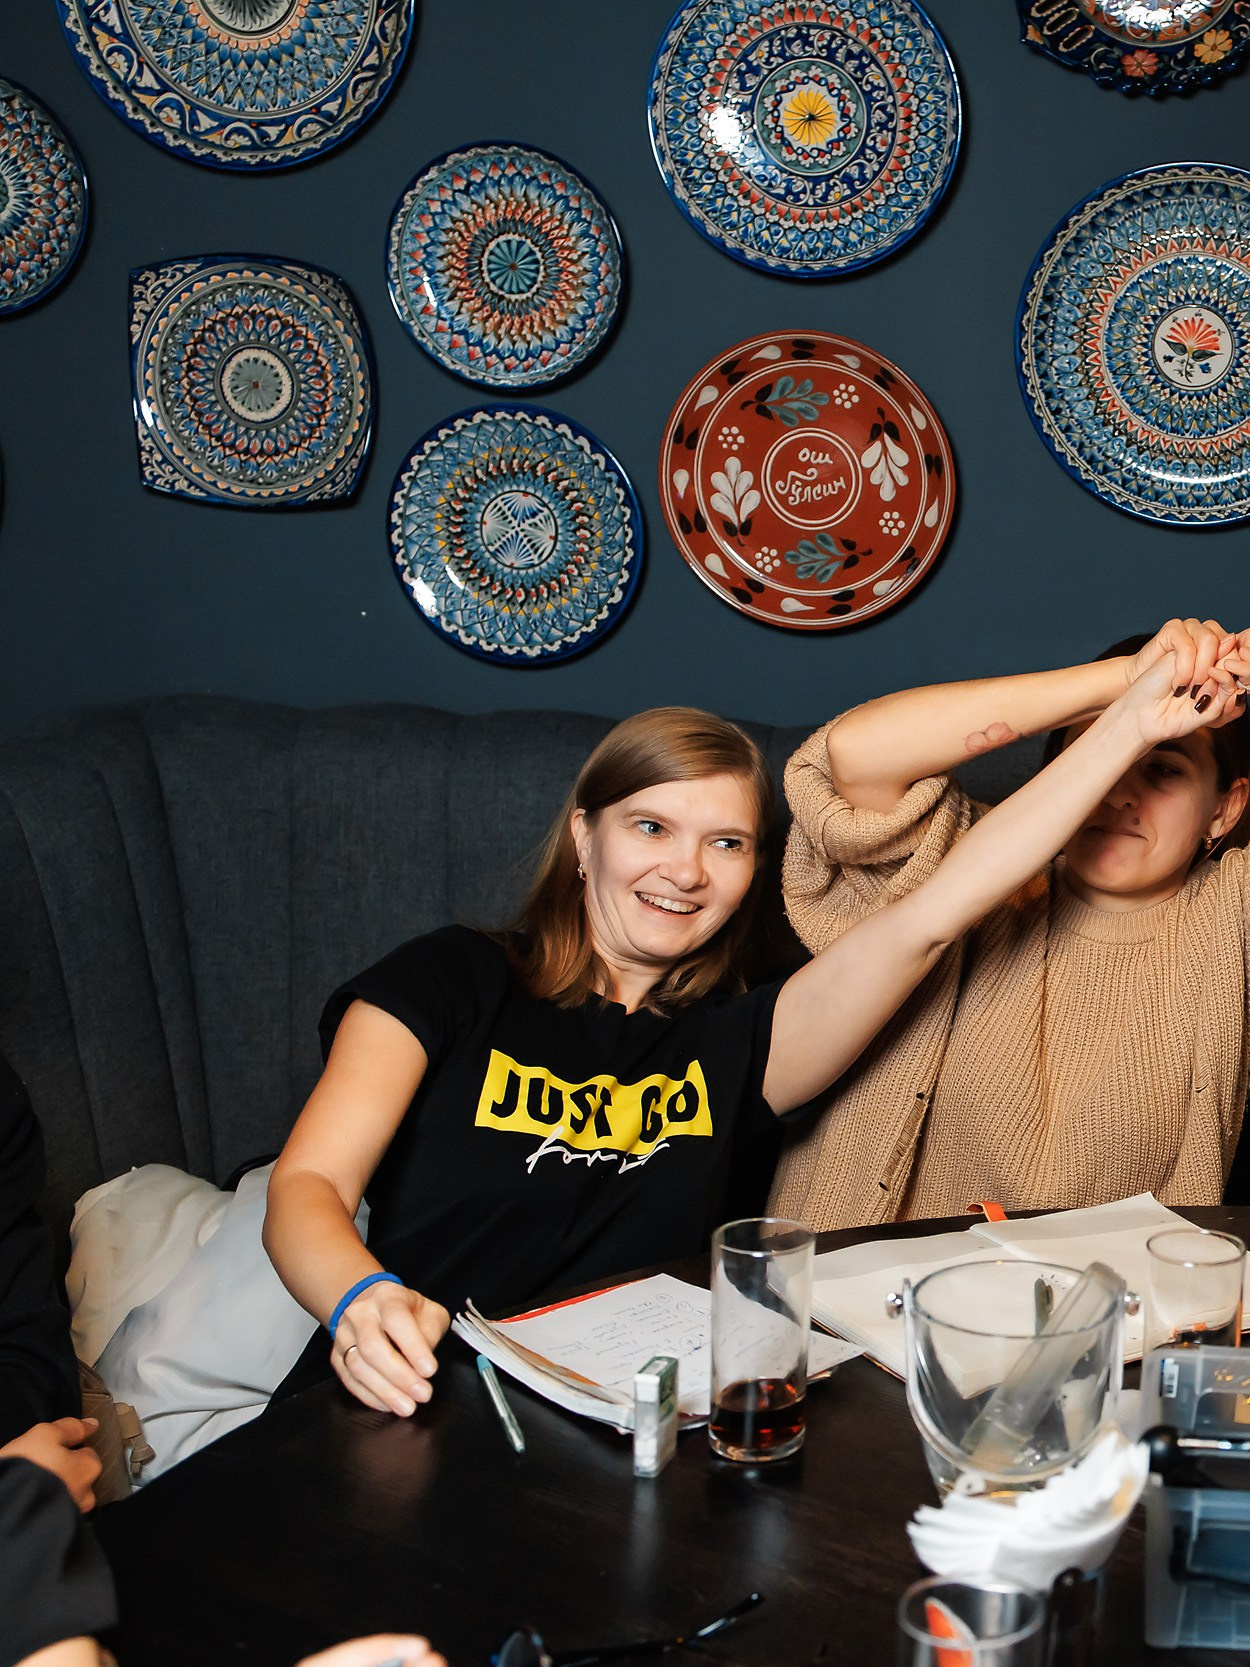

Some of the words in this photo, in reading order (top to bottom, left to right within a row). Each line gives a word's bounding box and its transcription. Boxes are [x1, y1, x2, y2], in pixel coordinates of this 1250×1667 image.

[490, 1068, 613, 1139] JUST
[638, 1079, 700, 1144] GO
[525, 1125, 618, 1174] for
